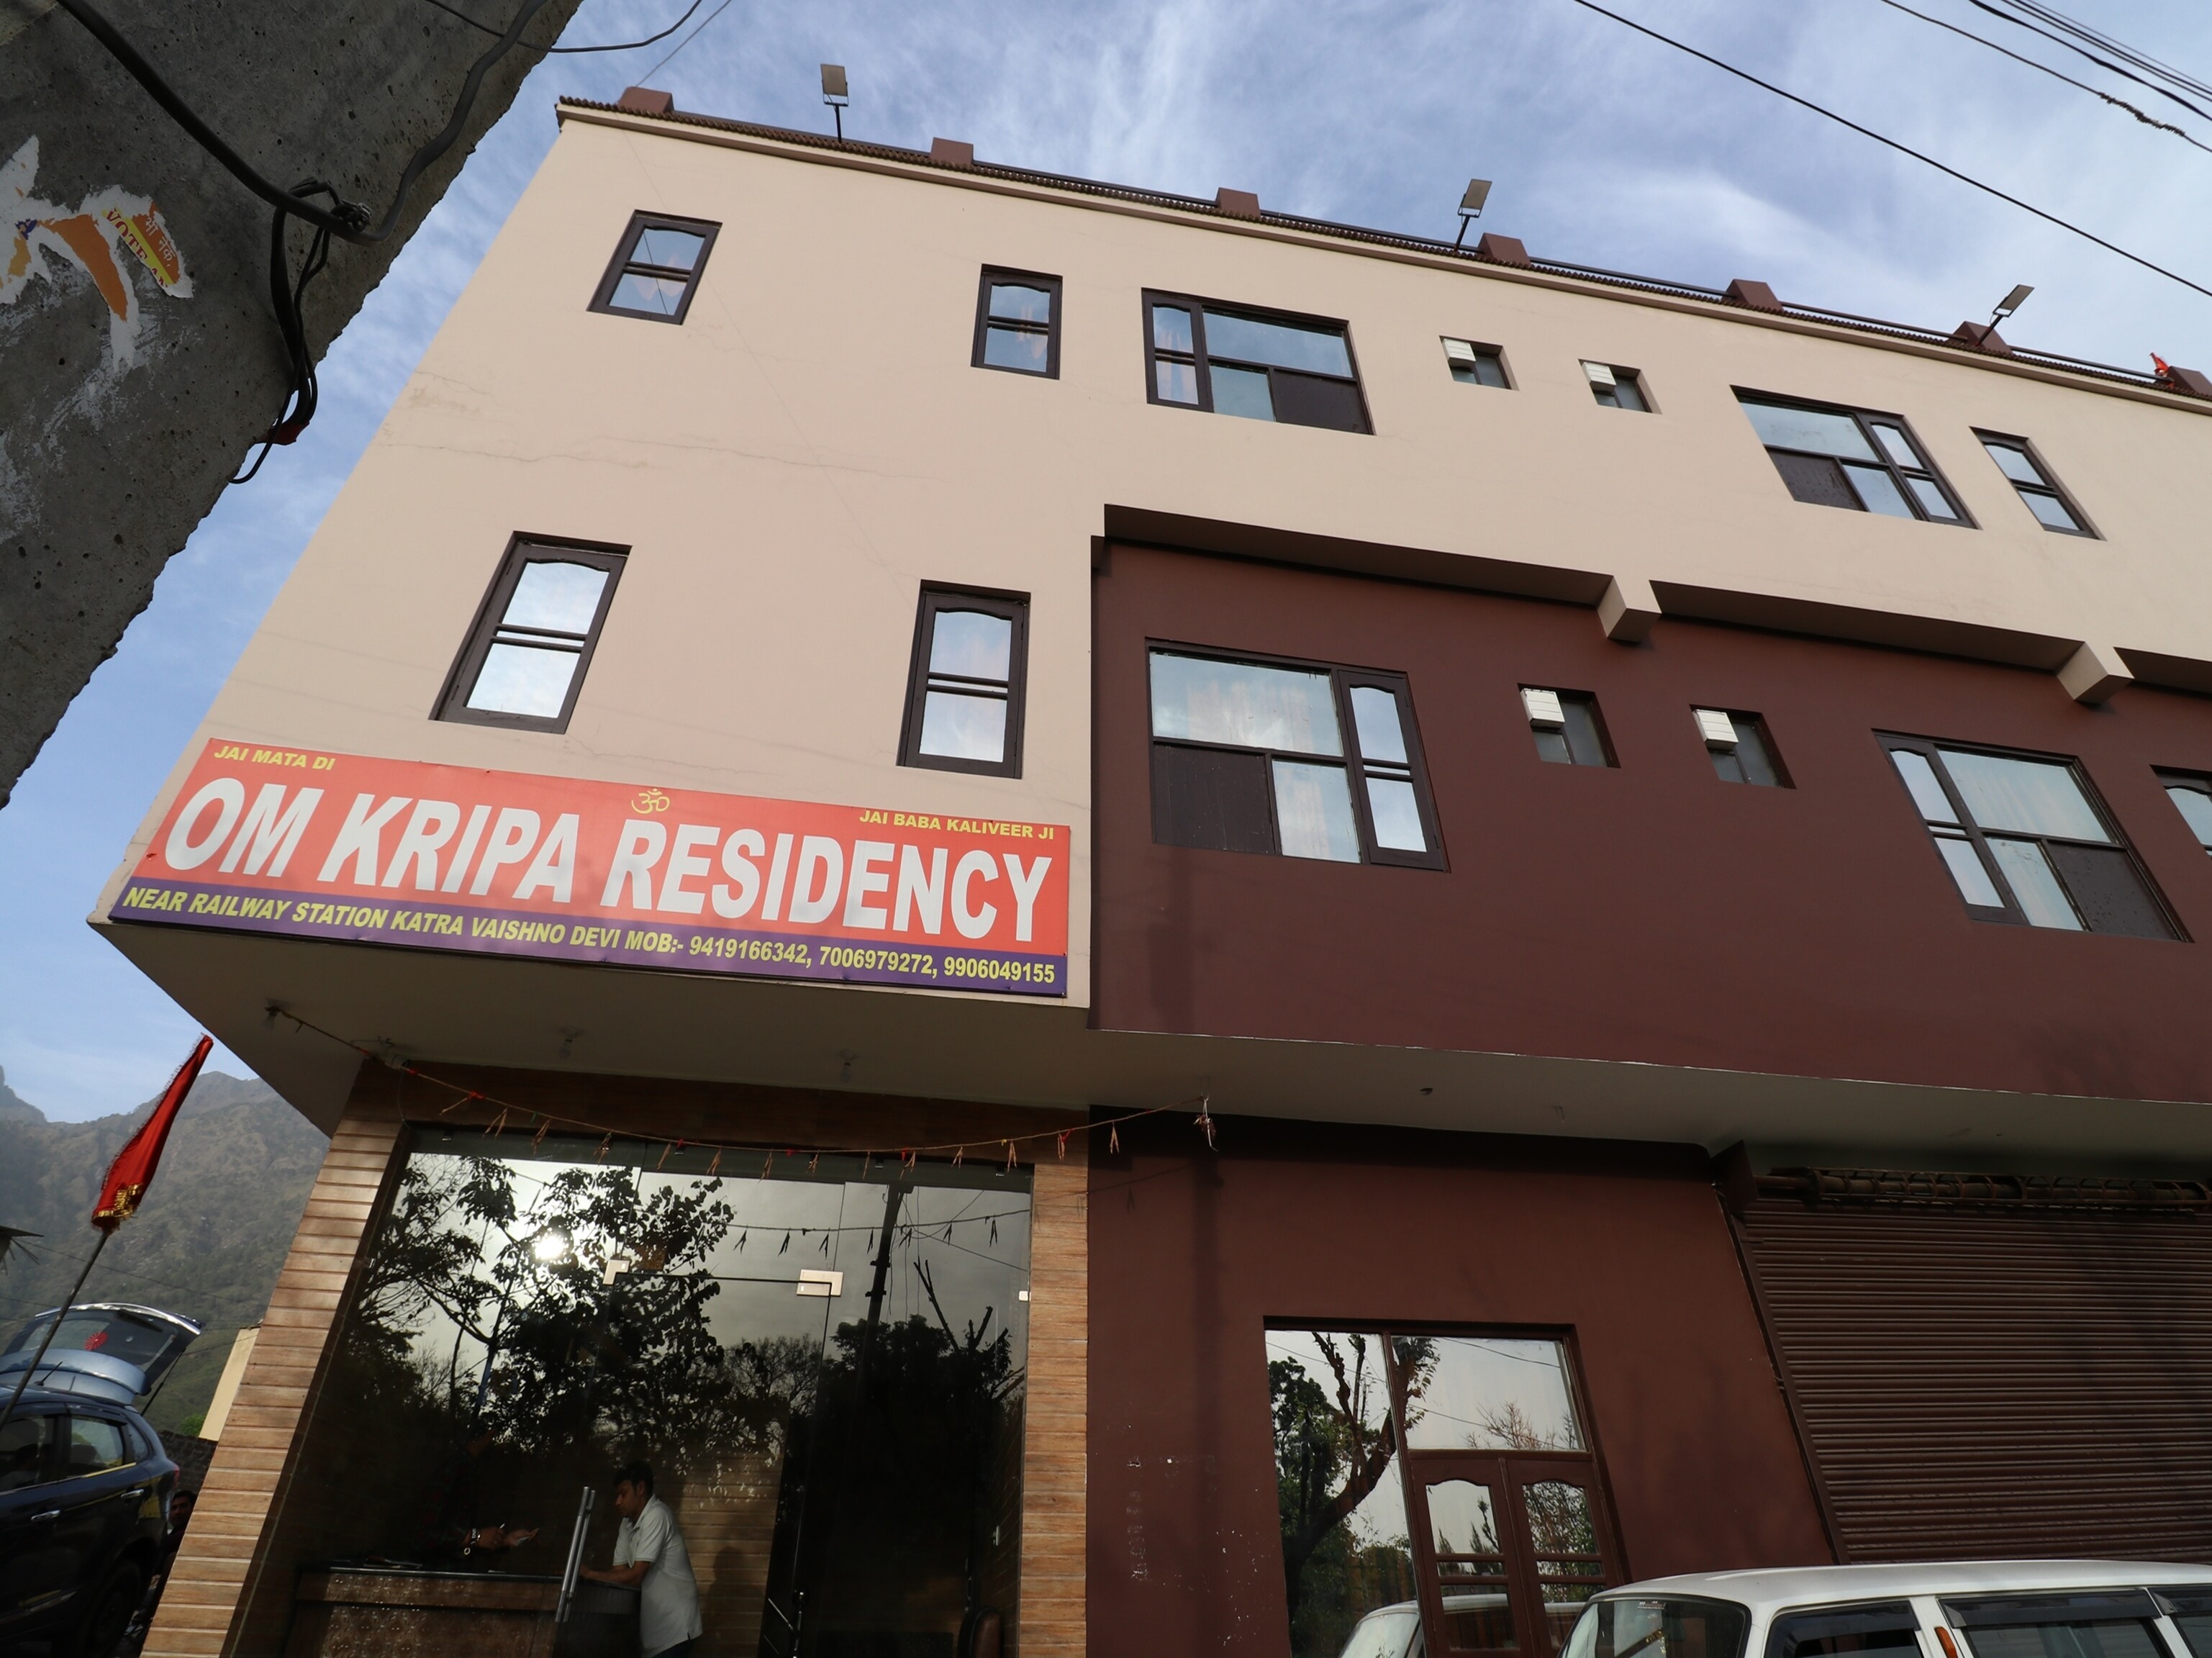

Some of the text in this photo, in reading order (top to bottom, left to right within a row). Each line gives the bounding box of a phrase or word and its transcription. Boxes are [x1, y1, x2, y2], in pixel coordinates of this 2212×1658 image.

[214, 746, 336, 771] JAI MATA DI
[859, 810, 1054, 840] JAI BABA KALIVEER JI
[165, 777, 1052, 943] OM KRIPA RESIDENCY
[122, 887, 188, 912] NEAR
[188, 892, 292, 920] RAILWAY
[291, 902, 389, 930] STATION
[390, 911, 463, 935] KATRA
[471, 917, 566, 943] VAISHNO
[570, 926, 621, 948] DEVI
[689, 936, 812, 969] 9419166342,
[819, 946, 938, 979] 7006979272,
[943, 956, 1056, 984] 9906049155
